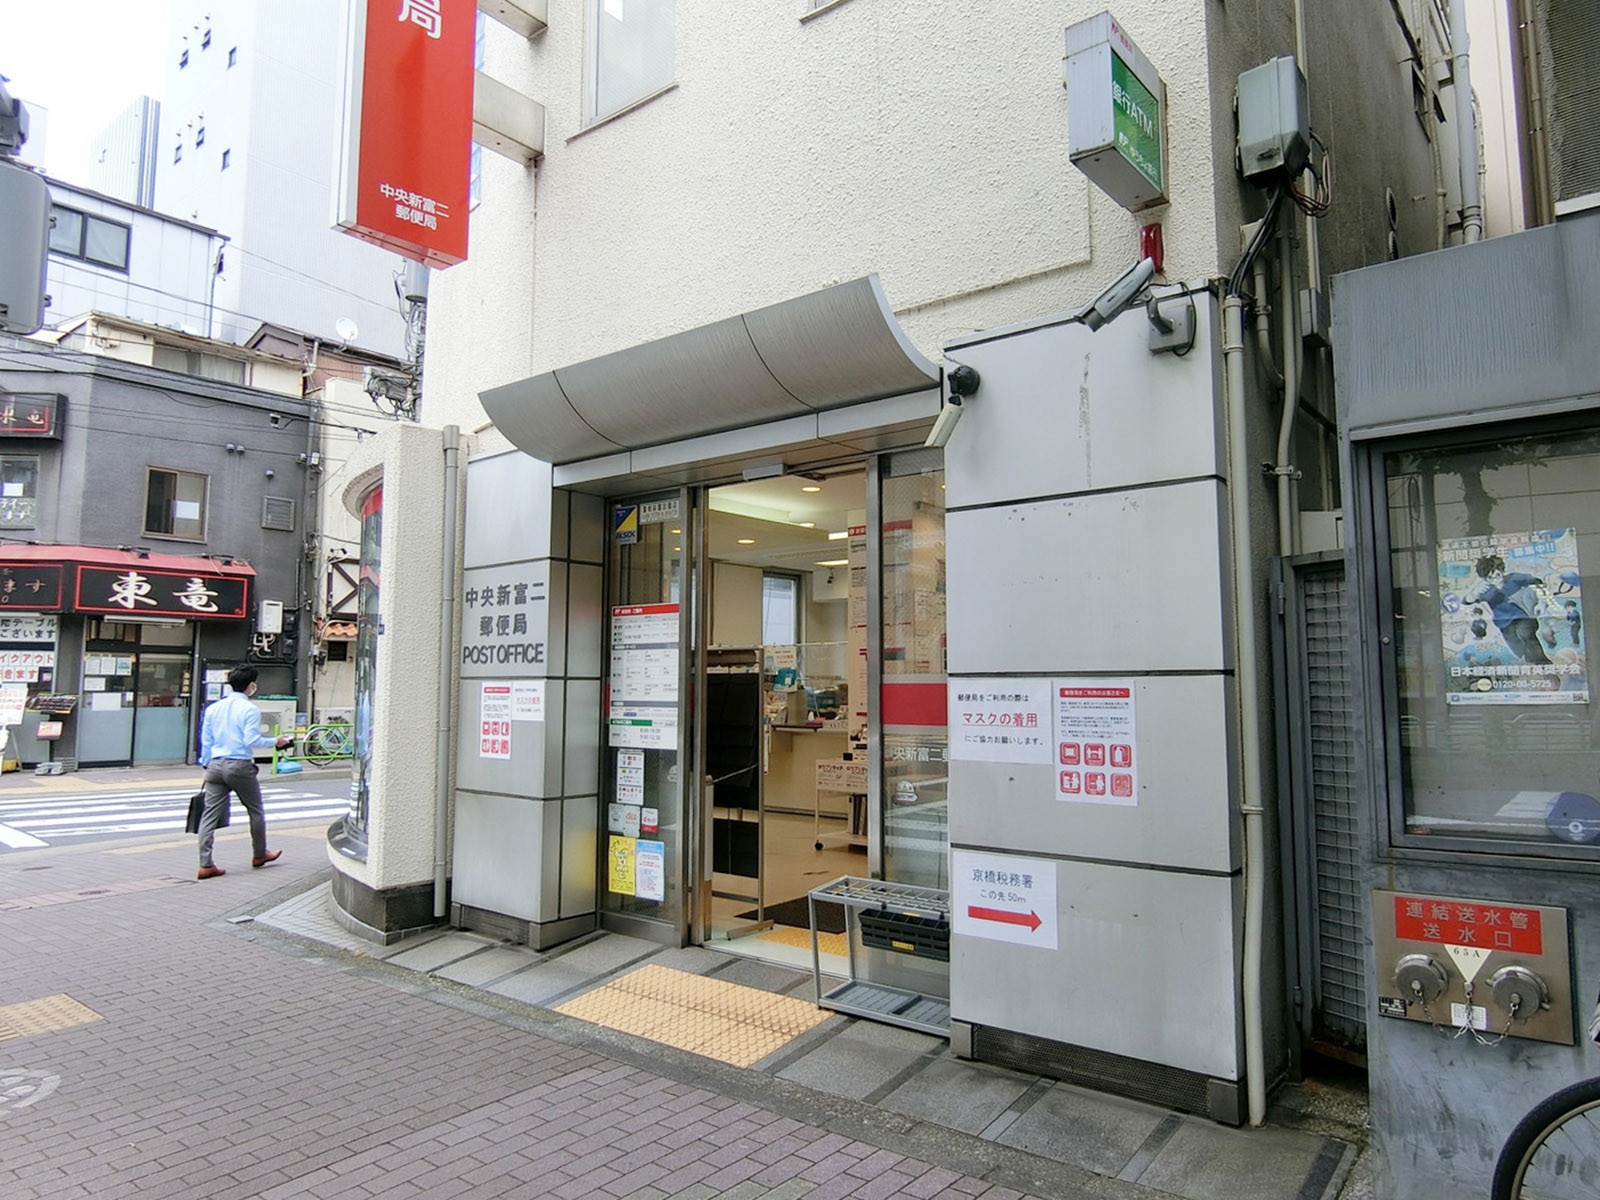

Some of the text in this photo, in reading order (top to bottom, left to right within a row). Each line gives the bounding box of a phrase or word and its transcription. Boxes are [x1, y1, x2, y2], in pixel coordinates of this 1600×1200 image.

[398, 0, 442, 39] 局
[1112, 80, 1153, 139] 銀行ATM
[380, 184, 449, 218] 中央新富二
[394, 204, 438, 231] 郵便局
[108, 571, 219, 612] 東竜
[465, 582, 545, 609] 中央新富二
[480, 613, 527, 637] 郵便局
[463, 643, 544, 664] POST OFFICE
[957, 693, 1029, 702] 郵便局をご利用の際は
[962, 712, 1038, 727] マスクの着用
[965, 735, 1044, 746] にご協力お願いします。
[972, 869, 1034, 888] 京橋税務署
[1406, 901, 1529, 930] 連結送水管
[1423, 922, 1512, 948] 送水口
[1453, 946, 1481, 958] 65A
